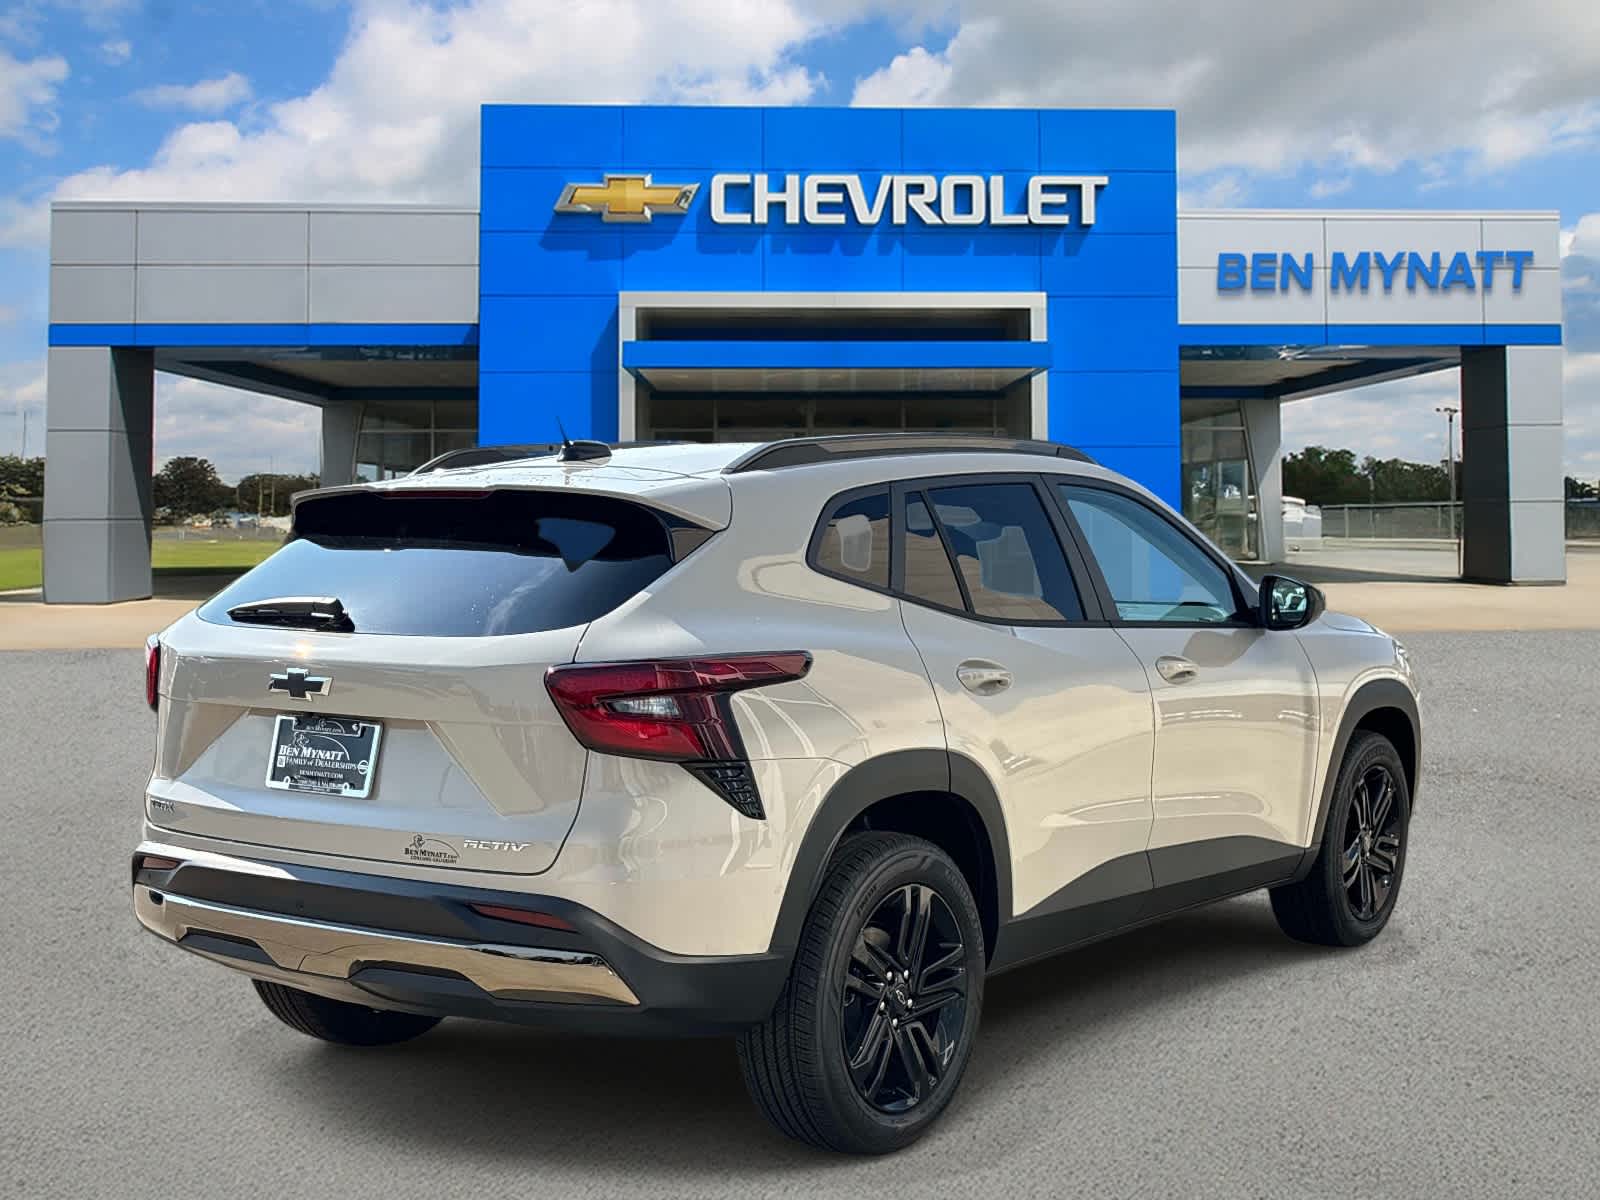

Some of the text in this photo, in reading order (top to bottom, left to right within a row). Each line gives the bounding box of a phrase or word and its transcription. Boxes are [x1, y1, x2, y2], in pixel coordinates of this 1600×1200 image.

[710, 173, 1109, 225] CHEVROLET
[1217, 250, 1535, 290] BEN MYNATT
[279, 744, 345, 761] BEN MYNATT
[286, 757, 307, 766] FAMILY
[314, 758, 358, 771] DEALERSHIPS
